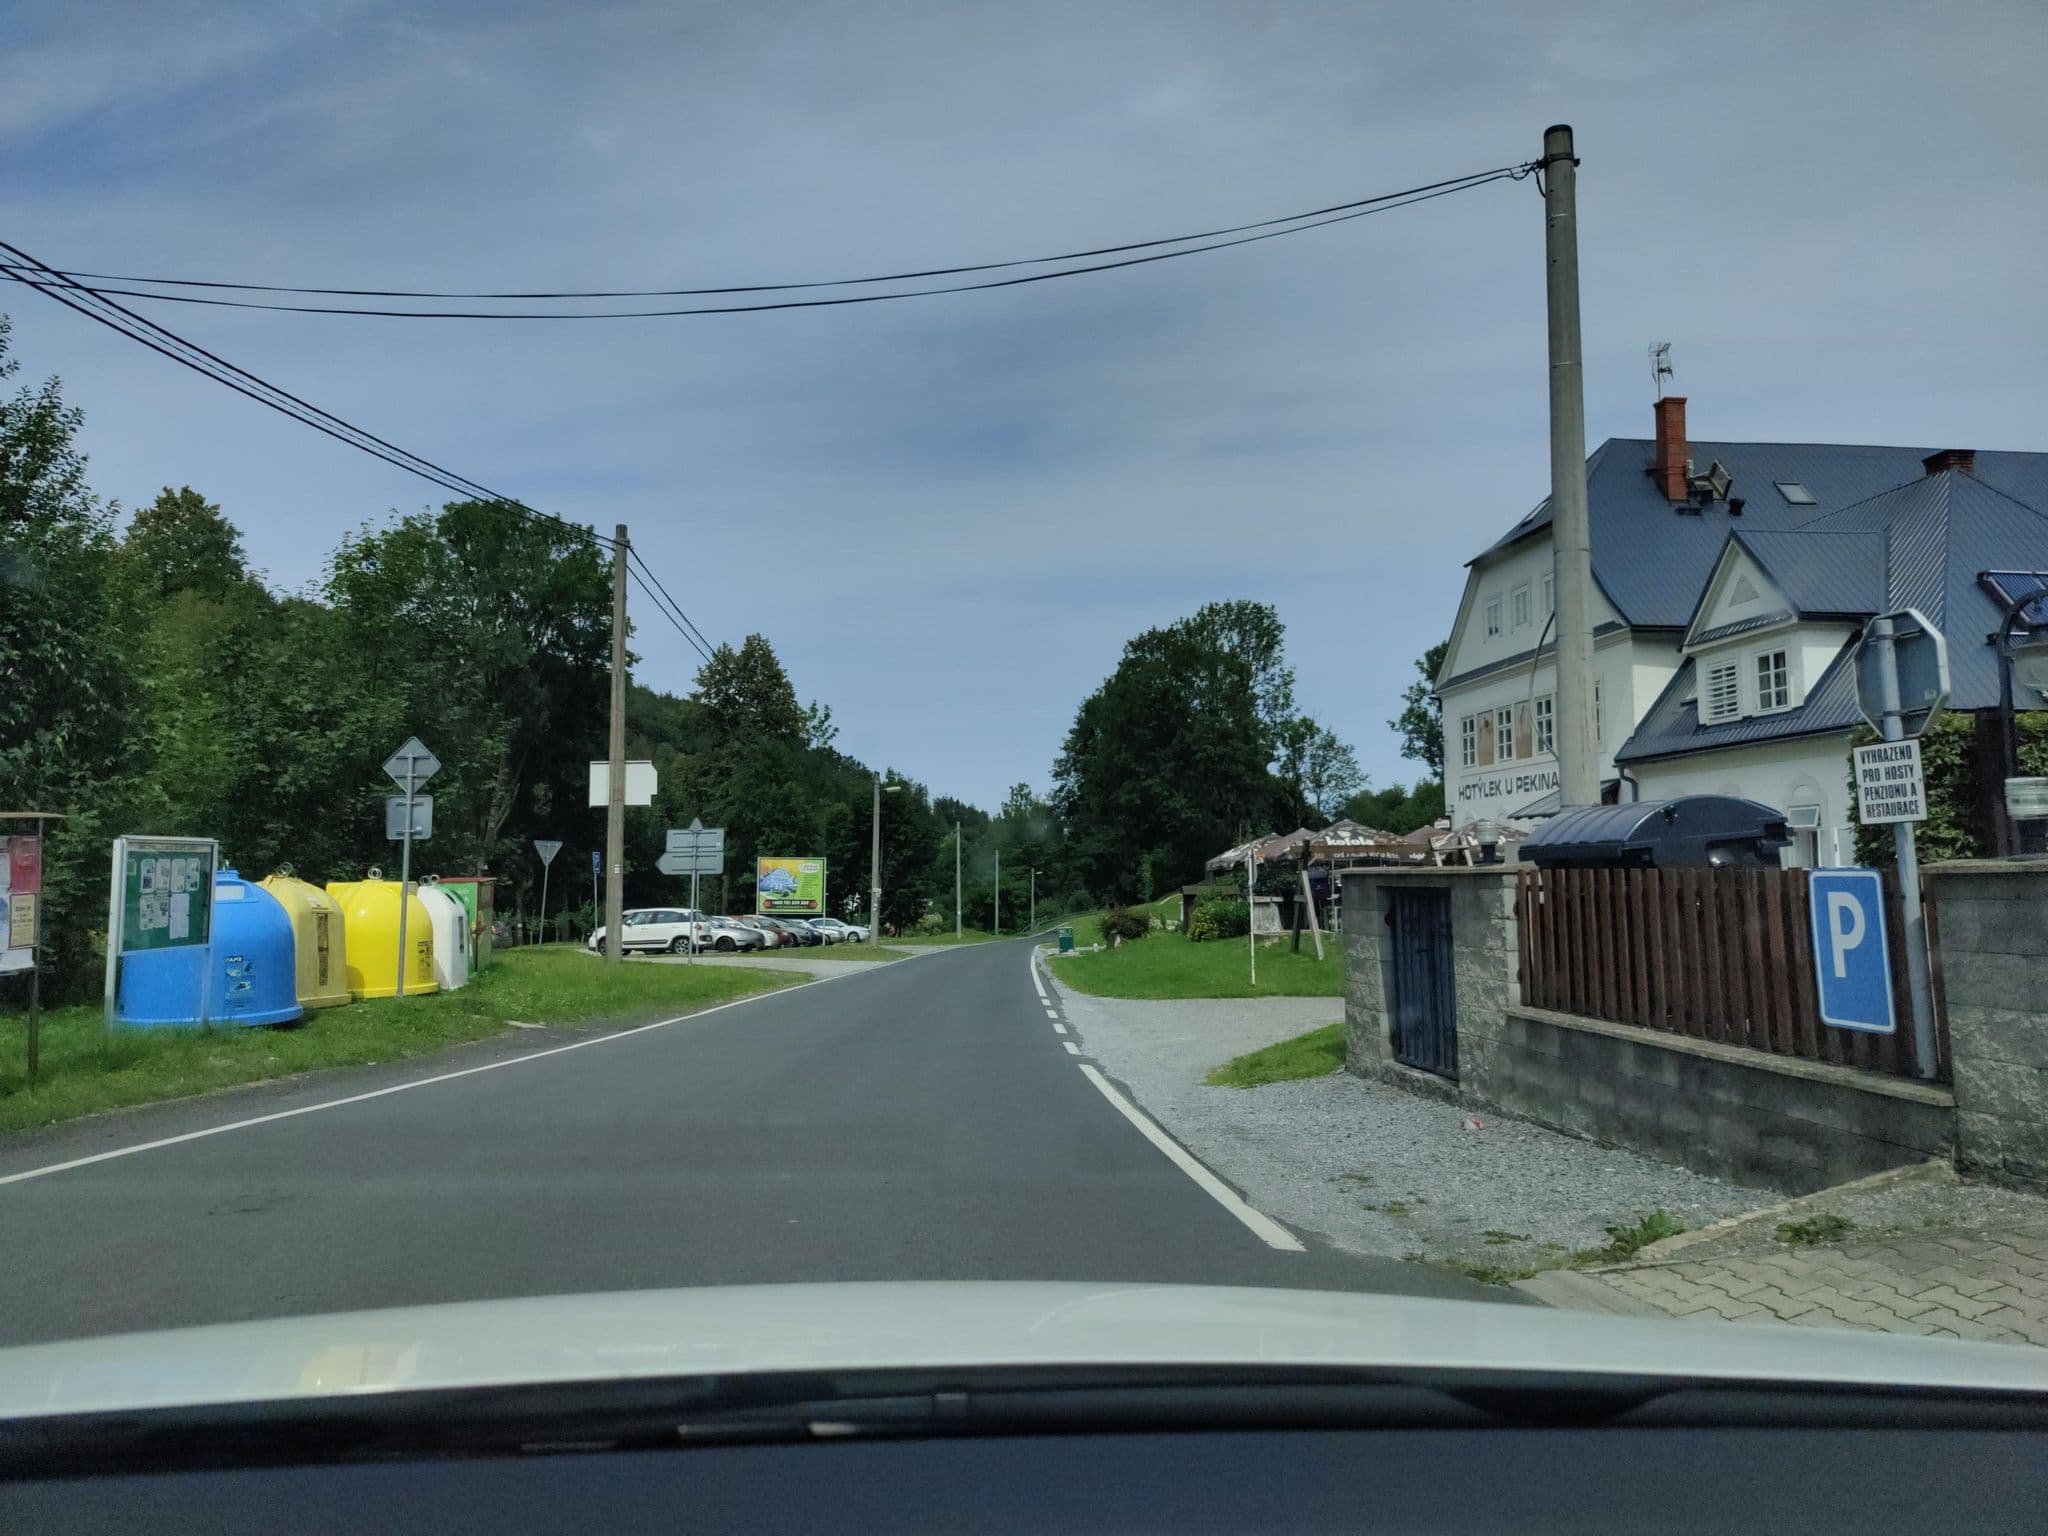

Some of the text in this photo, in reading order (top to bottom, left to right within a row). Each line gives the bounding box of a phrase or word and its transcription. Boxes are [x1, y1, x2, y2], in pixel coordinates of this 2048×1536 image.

[1860, 744, 1912, 765] VYHRAZENO
[1862, 764, 1914, 783] PRO HOSTY
[1458, 771, 1560, 801] HOTÝLEK U PEKINA
[1864, 782, 1918, 801] PENZIONU A
[1866, 800, 1920, 818] RESTAURACE
[1827, 891, 1866, 978] P
